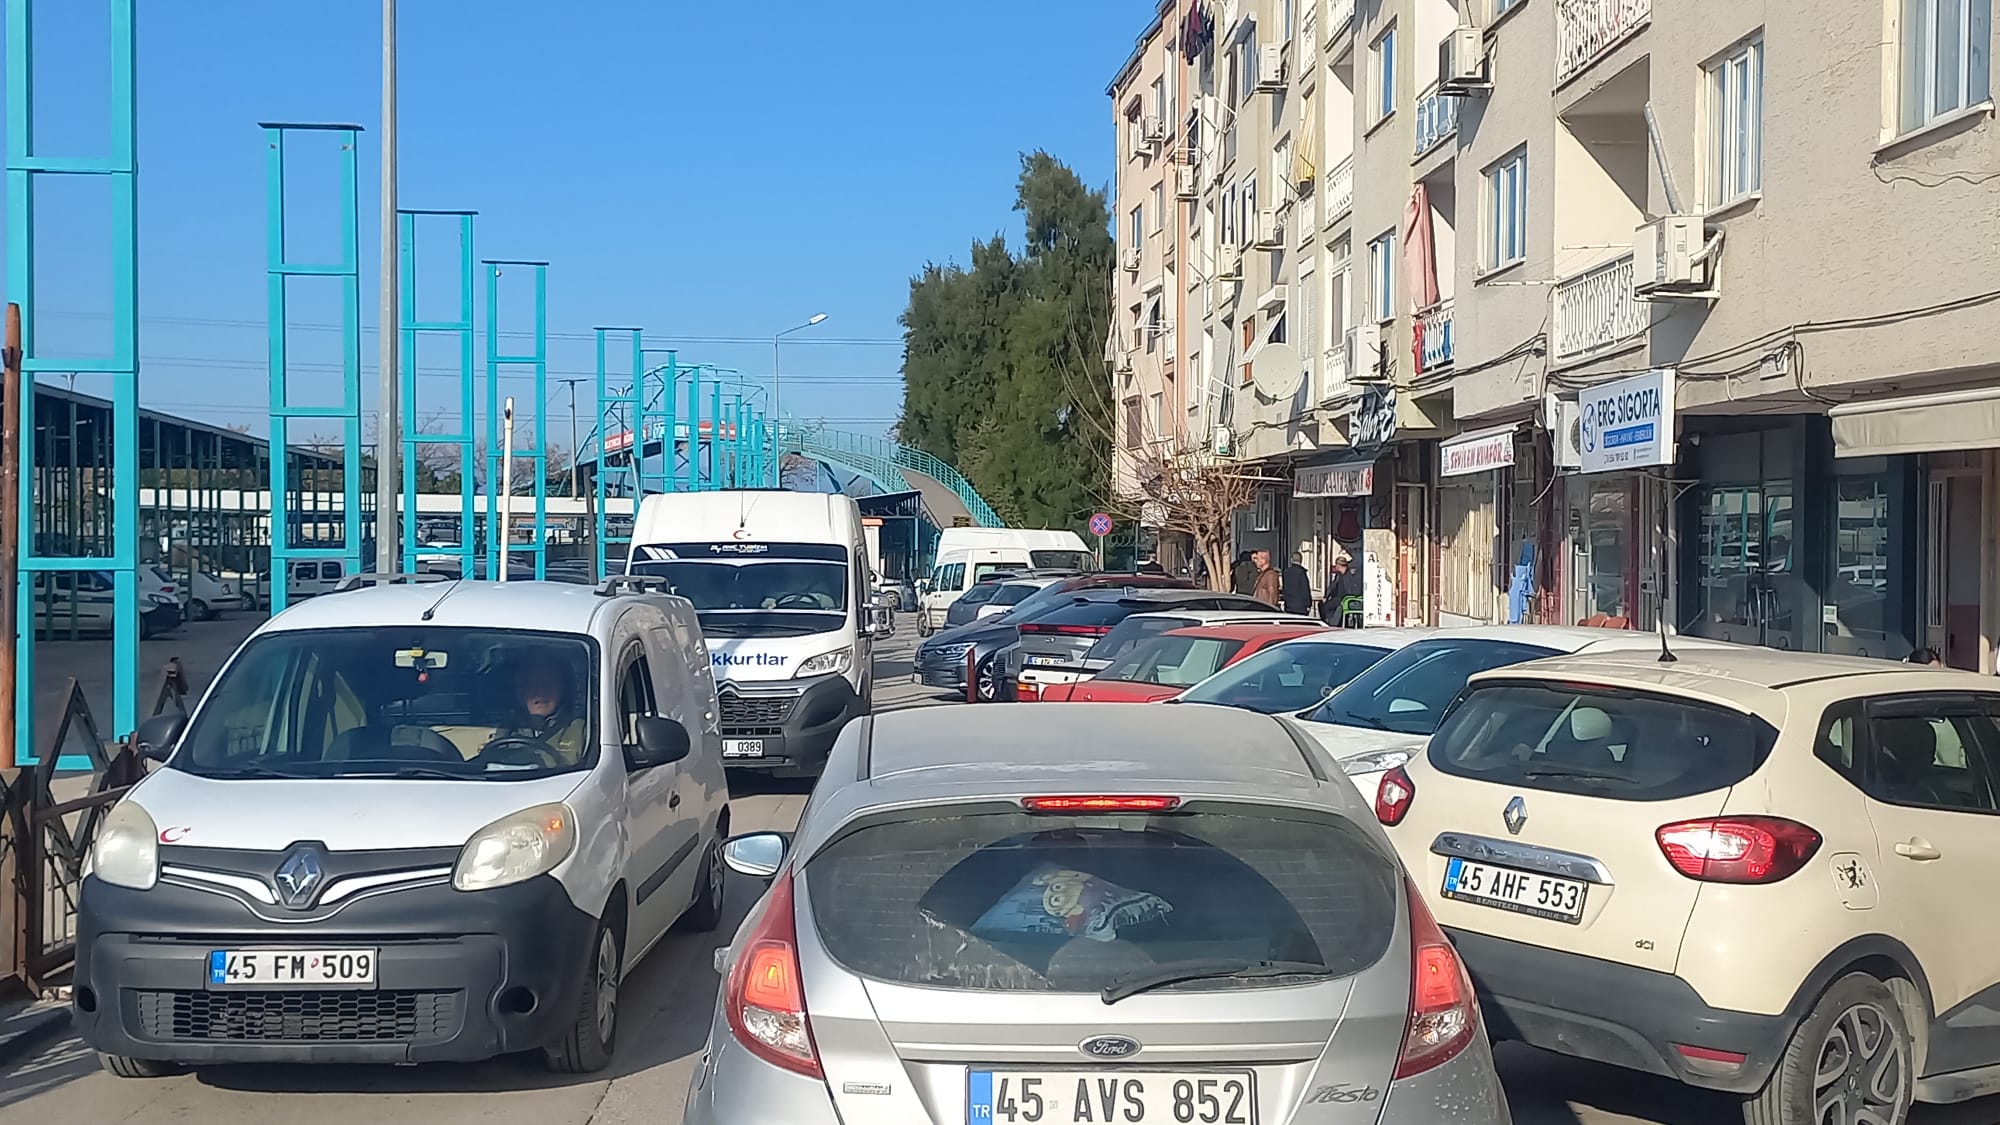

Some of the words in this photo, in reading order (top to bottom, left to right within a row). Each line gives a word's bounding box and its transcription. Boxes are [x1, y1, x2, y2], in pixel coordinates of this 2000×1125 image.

[1597, 397, 1616, 427] ERG
[1617, 387, 1660, 424] SİGORTA
[712, 652, 788, 666] kkurtlar
[738, 741, 761, 752] 0389
[1459, 865, 1484, 891] 45
[1490, 871, 1529, 900] AHF
[1537, 880, 1579, 910] 553
[214, 969, 224, 978] TR
[226, 955, 257, 979] 45
[274, 955, 305, 979] FM
[322, 954, 370, 979] 509
[1092, 1039, 1128, 1055] Ford
[972, 1104, 990, 1118] TR
[996, 1078, 1044, 1123] 45
[1073, 1078, 1145, 1123] AVS
[1173, 1078, 1246, 1124] 852
